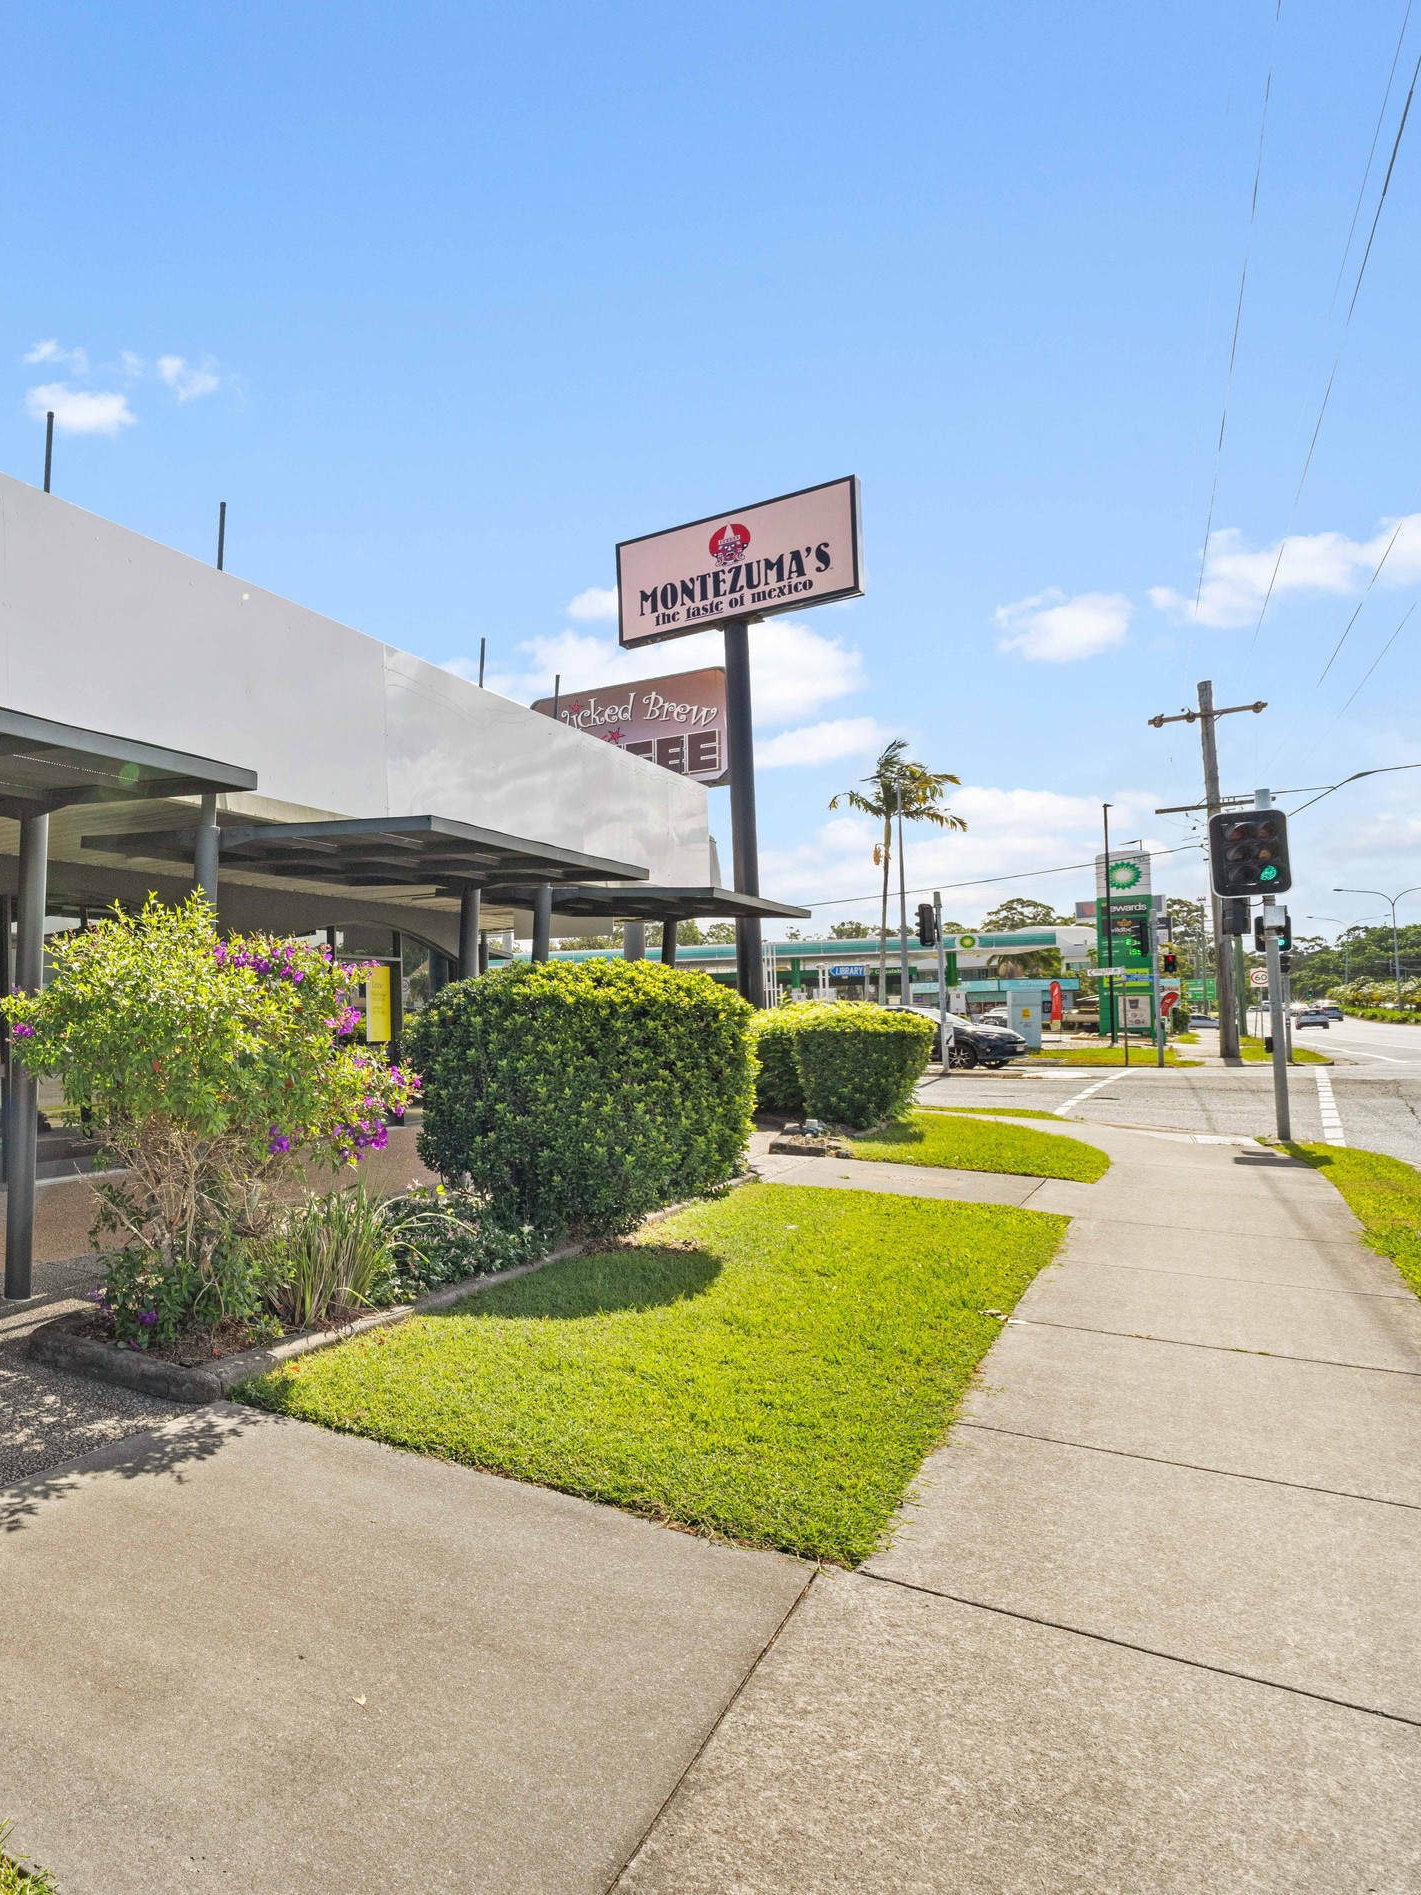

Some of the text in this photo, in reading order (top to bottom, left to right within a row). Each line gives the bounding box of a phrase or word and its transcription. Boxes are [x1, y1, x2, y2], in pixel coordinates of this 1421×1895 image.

[639, 542, 831, 617] MONTEZUMA'S
[655, 579, 814, 627] the taste of mexico
[561, 691, 718, 730] icked Brew
[1109, 902, 1147, 913] ewards
[835, 966, 863, 976] LIBRARY
